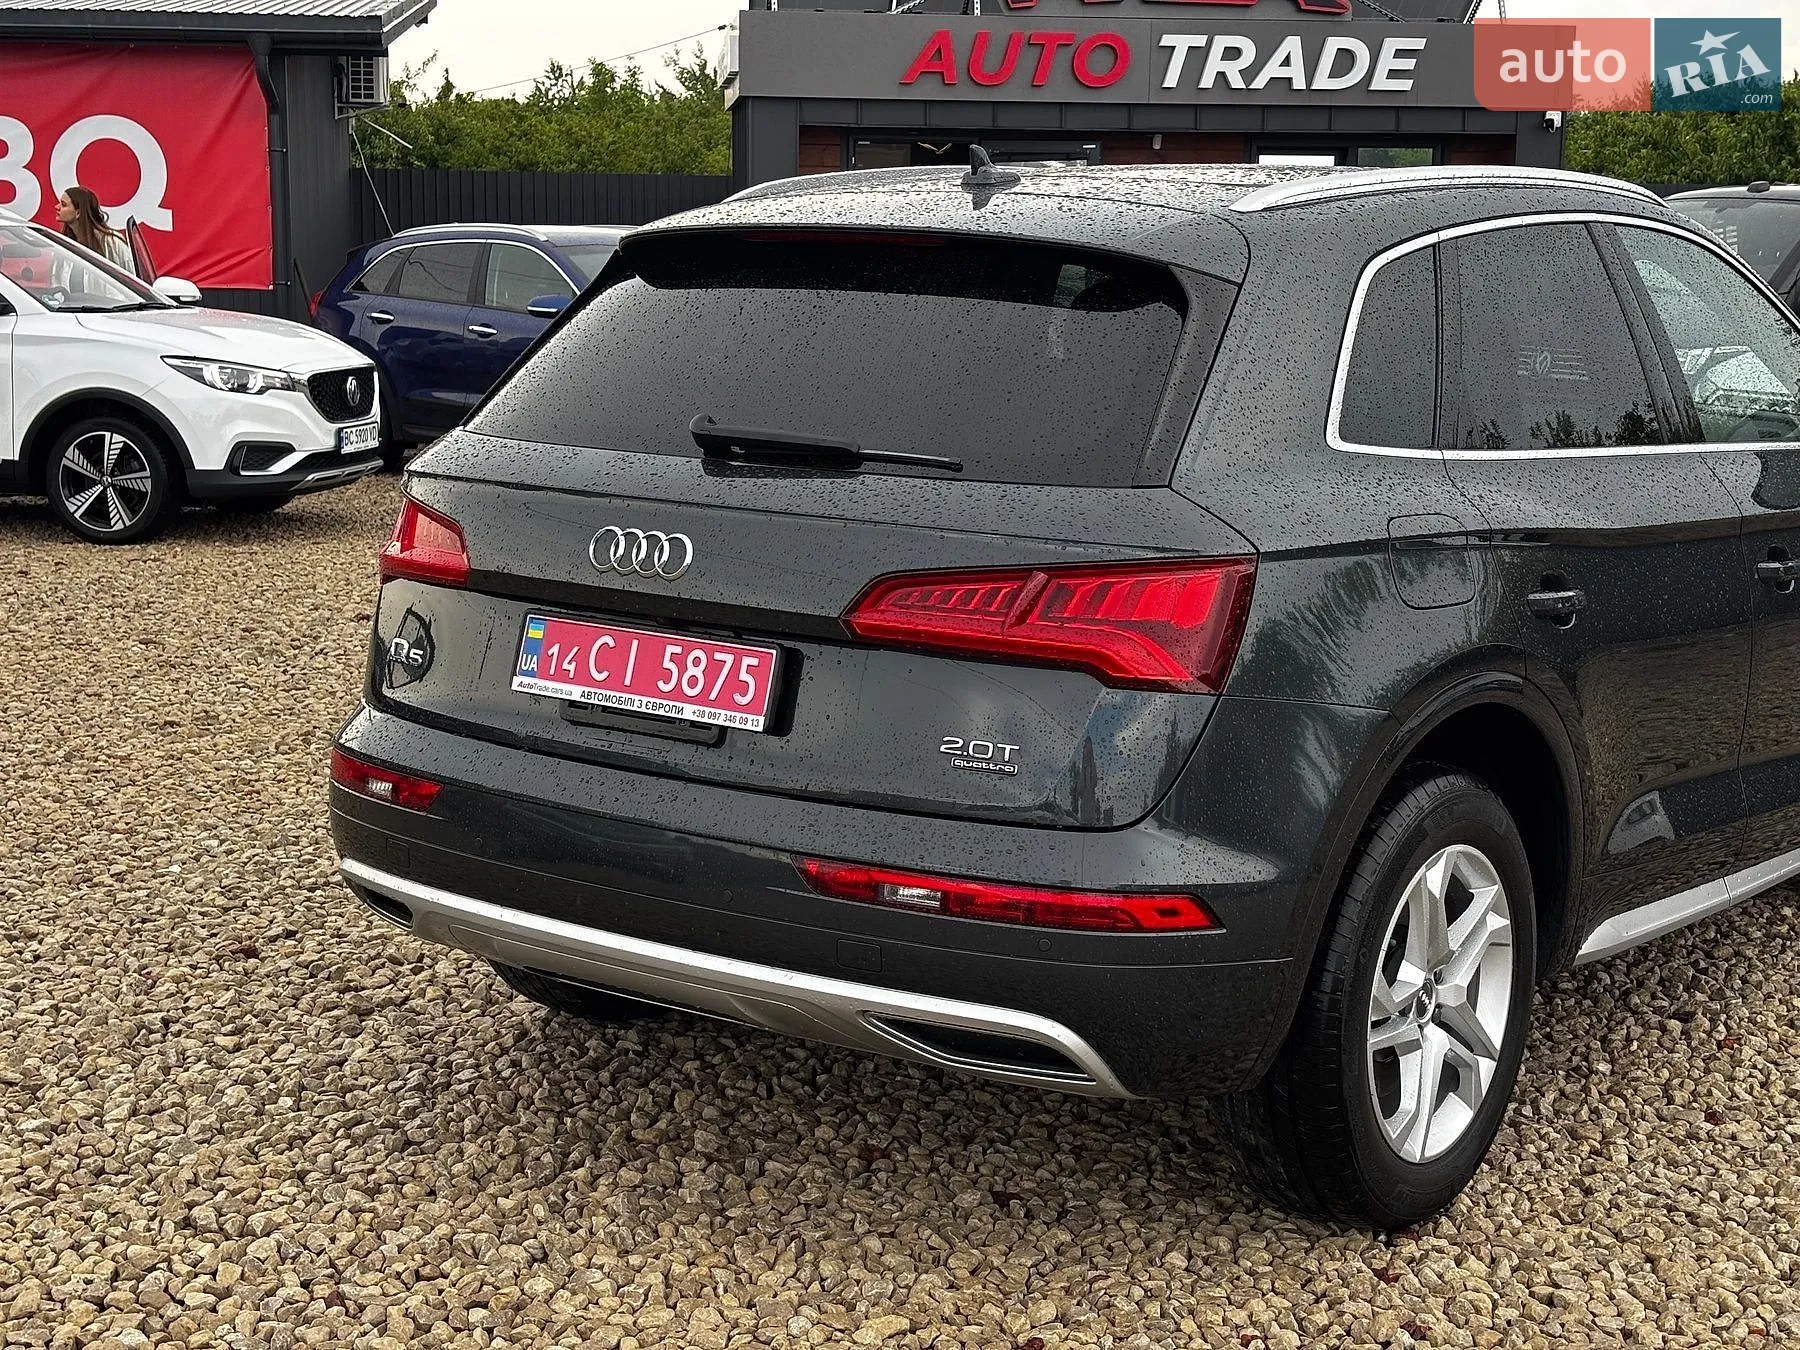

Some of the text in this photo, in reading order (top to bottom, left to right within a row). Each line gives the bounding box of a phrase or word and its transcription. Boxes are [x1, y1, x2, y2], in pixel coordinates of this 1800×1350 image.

[900, 29, 1428, 91] AUTO TRADE
[391, 637, 423, 667] Q5
[521, 653, 538, 672] UA
[547, 642, 580, 679] 14
[656, 643, 760, 706] 5875
[580, 690, 635, 708] АВТОМОБІЛІ
[645, 700, 685, 716] ЄВРОПИ
[691, 709, 707, 719] +38
[707, 711, 721, 721] 097
[738, 716, 749, 726] 09
[750, 718, 760, 728] 13
[940, 736, 1020, 762] 2.0T
[954, 760, 1014, 771] quattro
